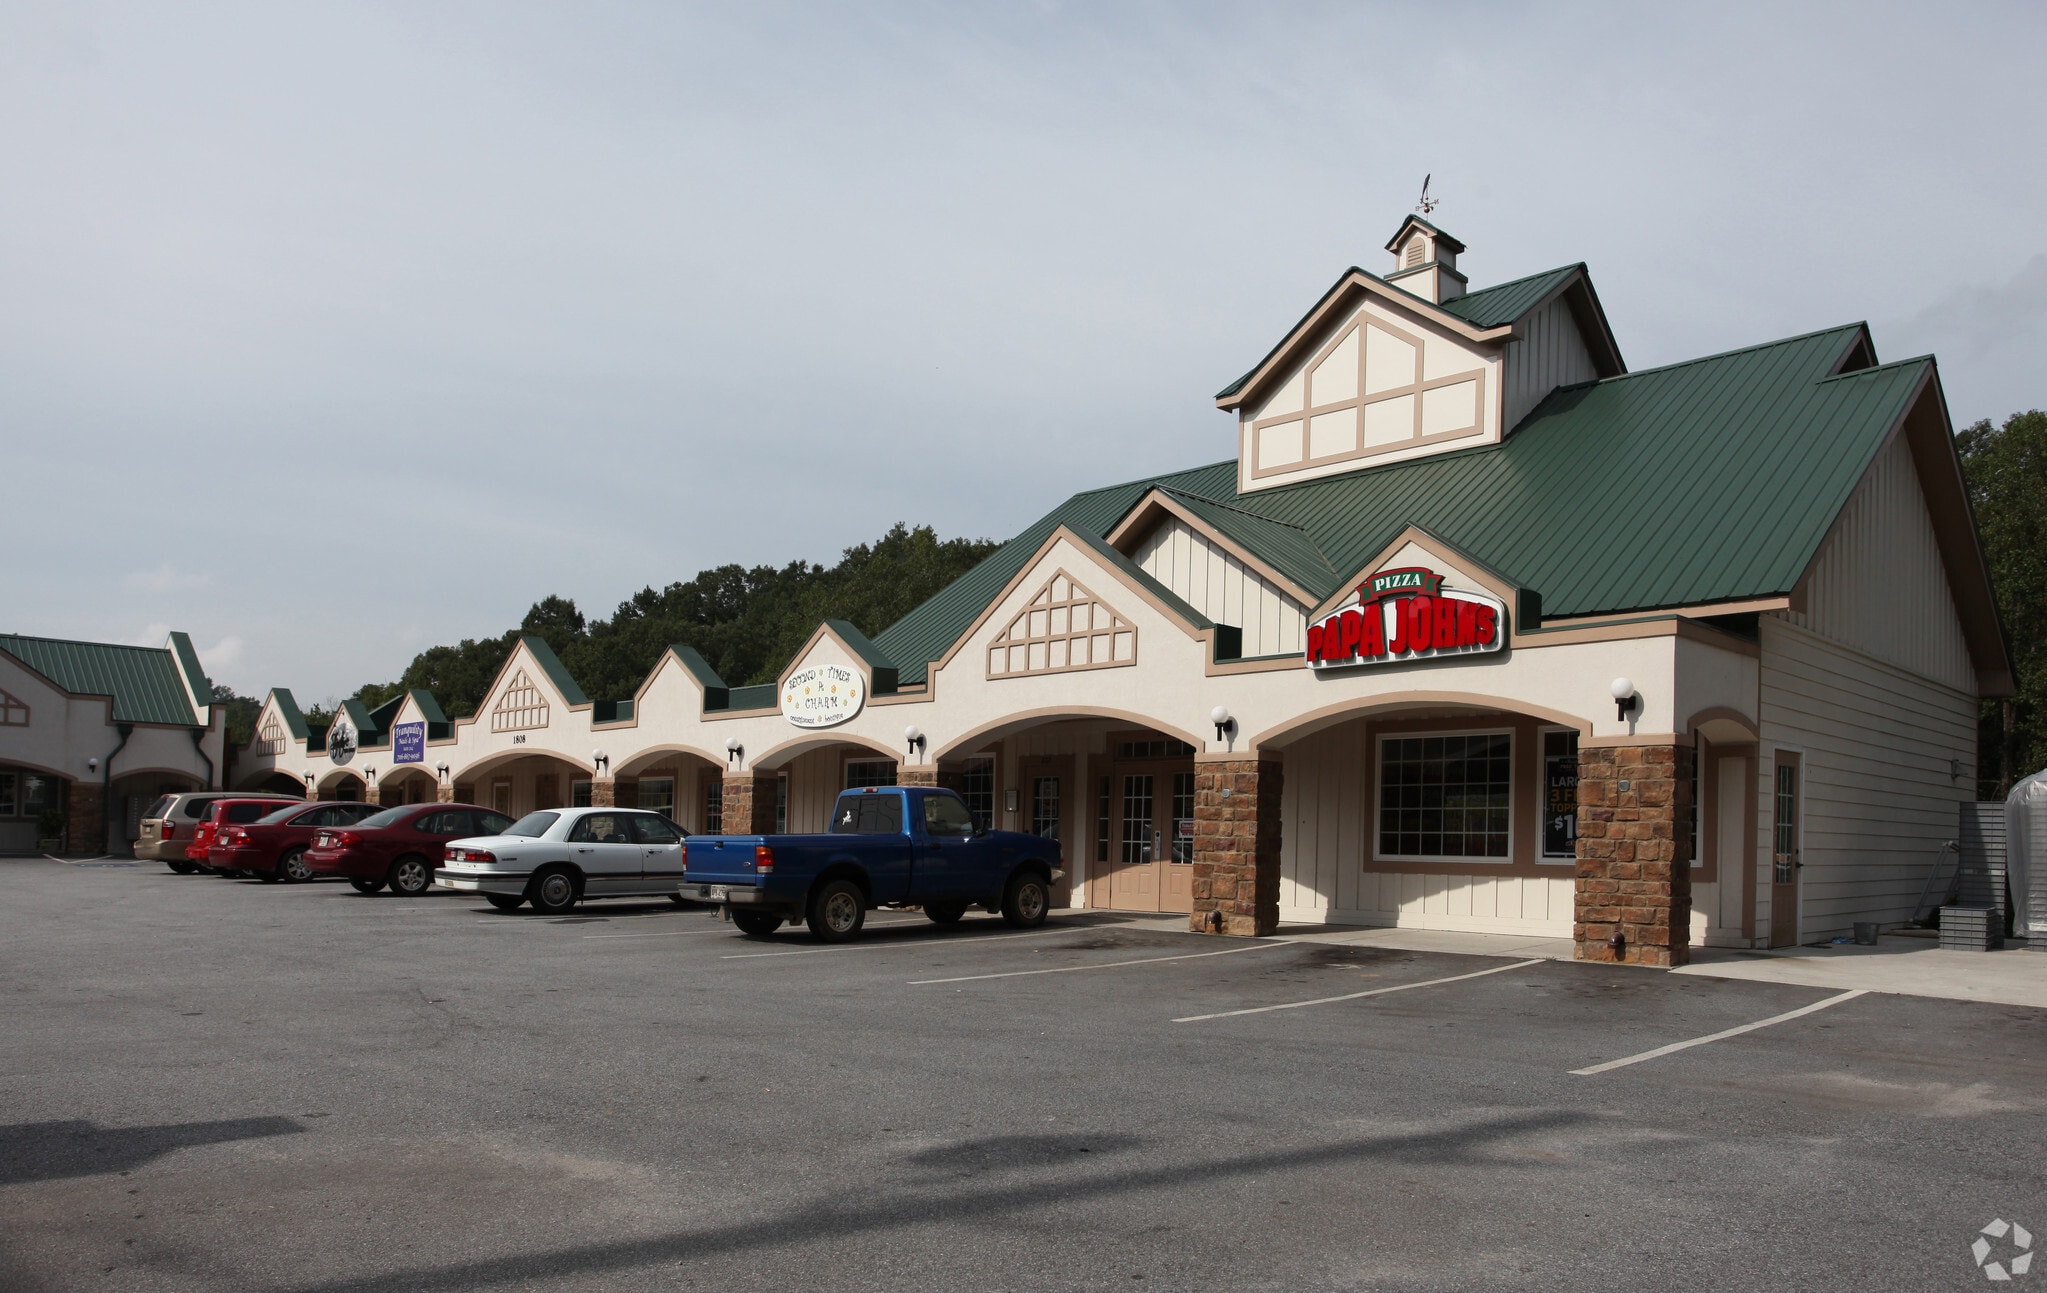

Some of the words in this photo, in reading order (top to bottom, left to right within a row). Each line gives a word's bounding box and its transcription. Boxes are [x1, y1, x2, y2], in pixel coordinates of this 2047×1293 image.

[1375, 573, 1421, 592] PIZZA
[1307, 602, 1385, 662] PAPA
[789, 670, 816, 690] SECOND
[827, 666, 851, 683] TIMES
[805, 697, 838, 709] CHARM
[1552, 789, 1560, 801] 3
